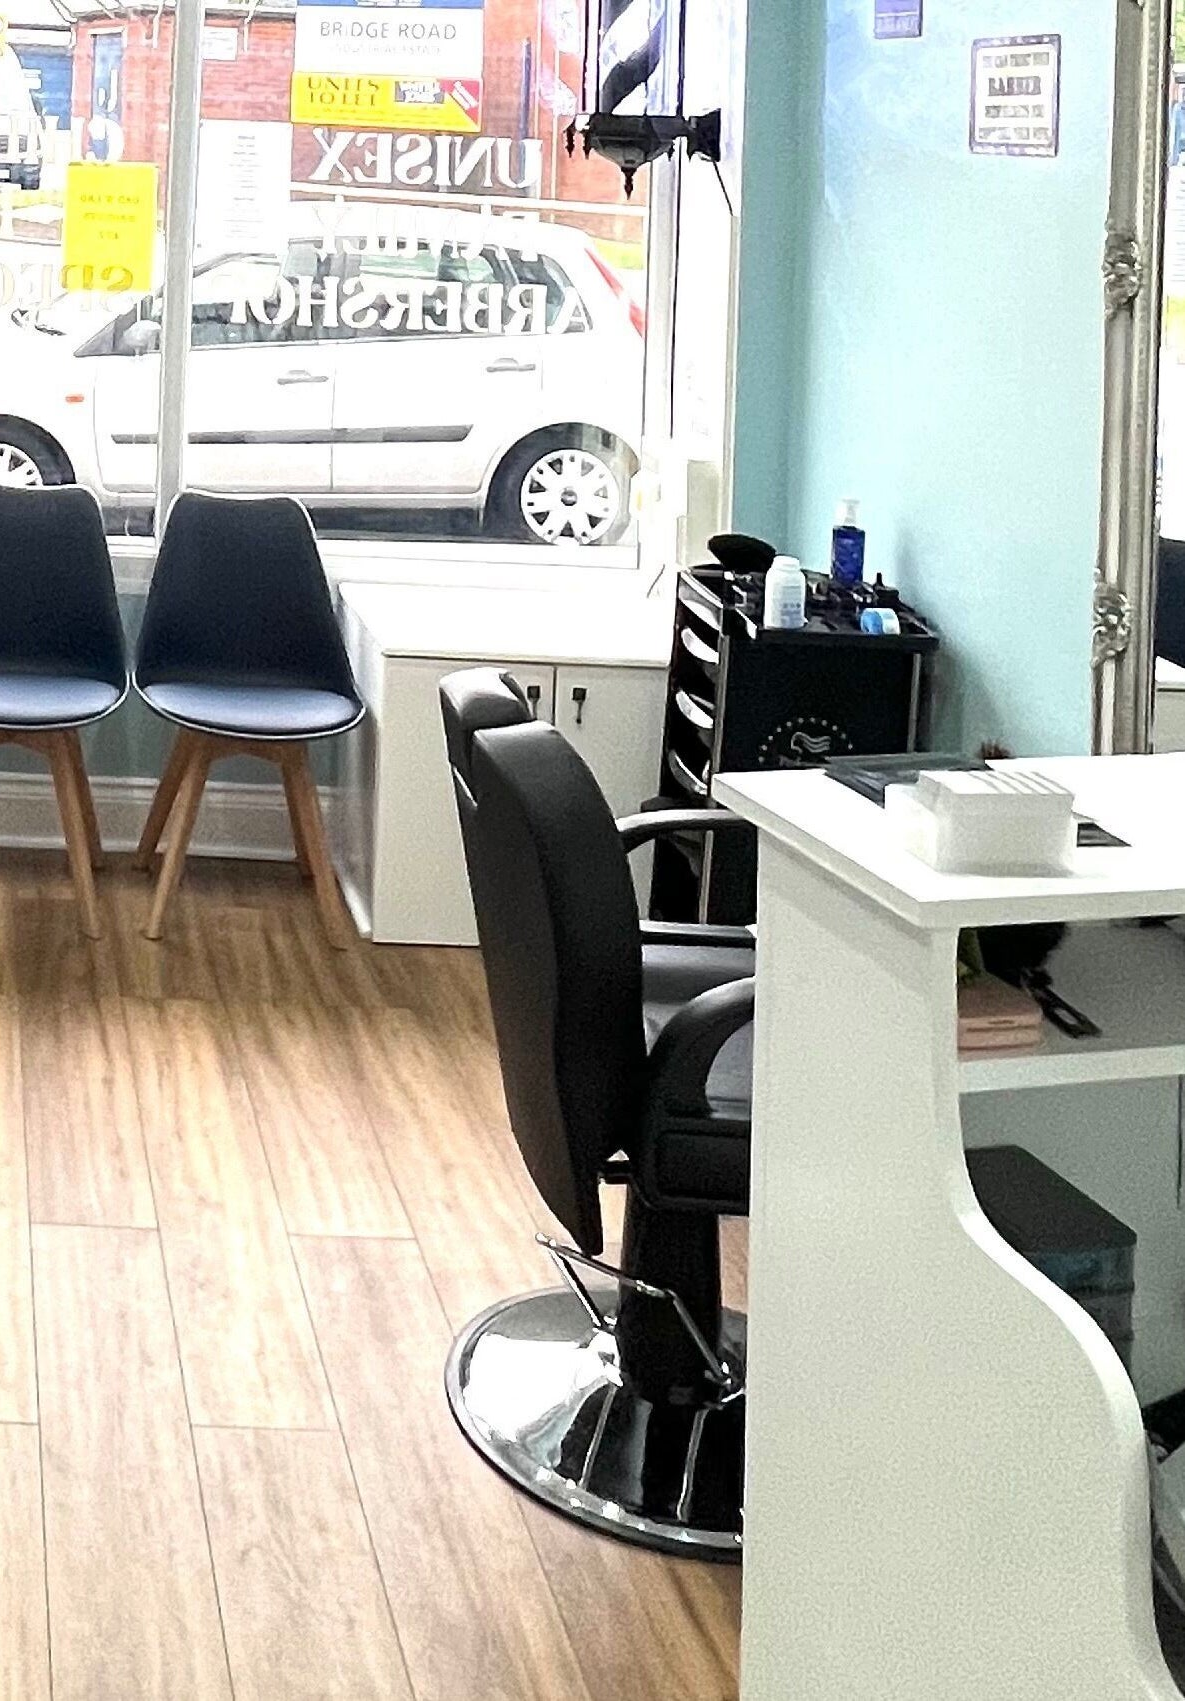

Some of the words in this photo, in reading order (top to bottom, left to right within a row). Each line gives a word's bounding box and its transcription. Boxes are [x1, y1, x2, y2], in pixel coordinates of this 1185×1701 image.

[320, 20, 390, 38] BRIDGE
[398, 22, 457, 40] ROAD
[307, 76, 380, 92] UNITS
